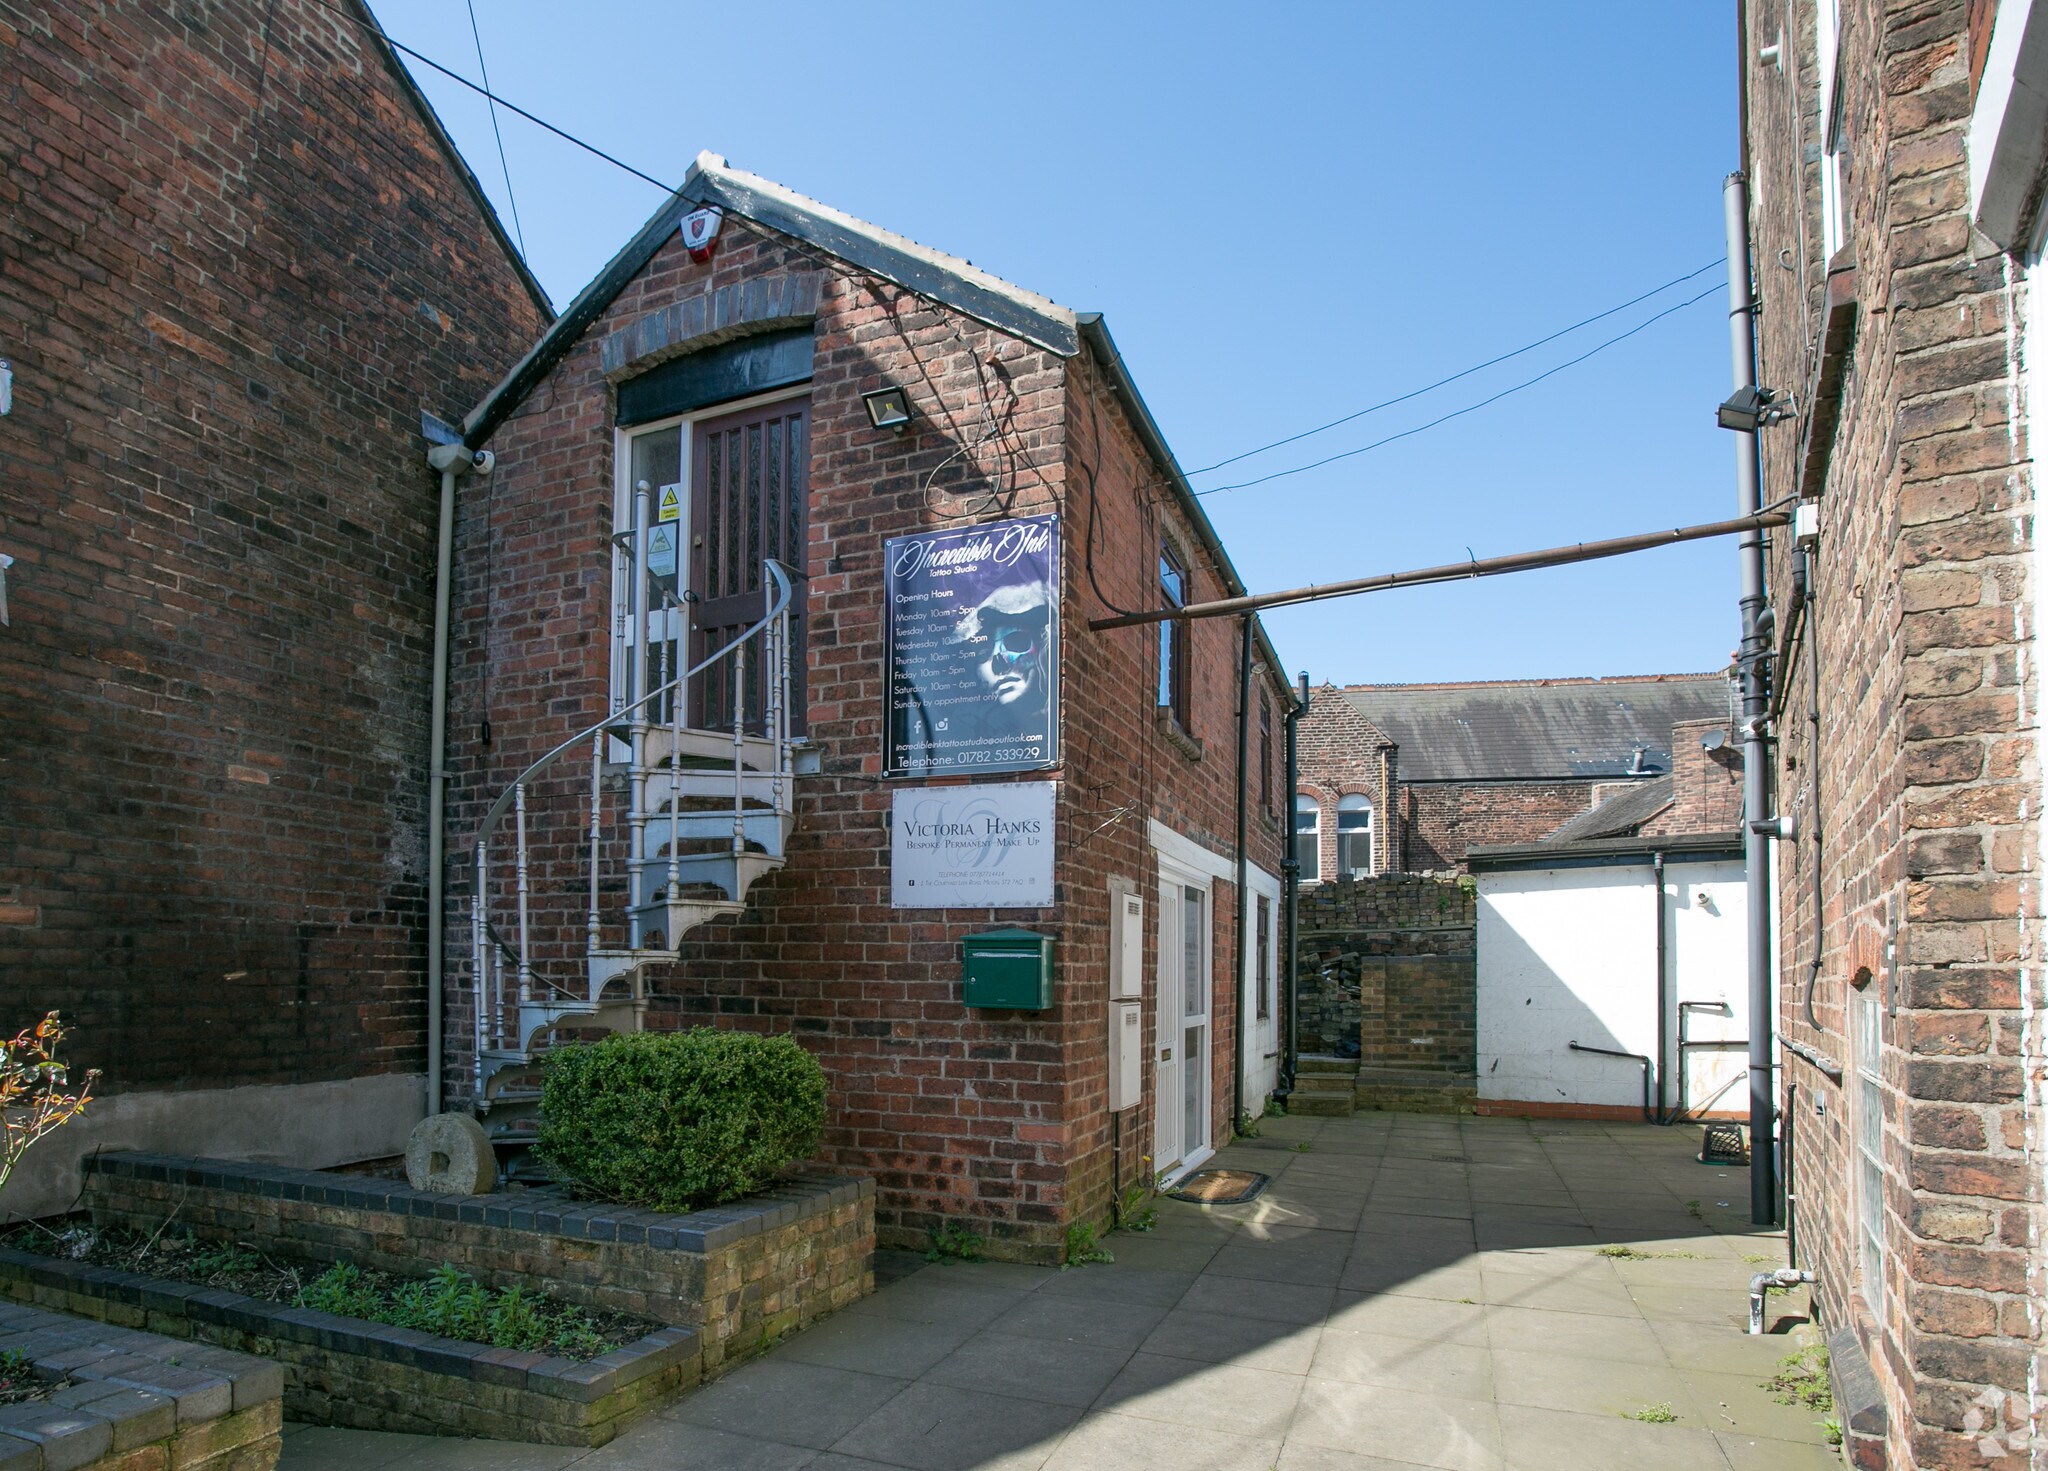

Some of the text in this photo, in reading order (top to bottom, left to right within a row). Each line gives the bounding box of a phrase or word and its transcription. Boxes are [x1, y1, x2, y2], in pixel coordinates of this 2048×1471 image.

[893, 523, 1049, 581] Incredible Ink
[929, 564, 978, 578] Tattoo Studio
[895, 589, 954, 604] Opening Hours
[895, 611, 928, 622] Monday
[930, 608, 951, 618] 10am
[958, 605, 977, 616] 5pm
[895, 626, 925, 637] Tuesday
[927, 623, 948, 633] 10am
[895, 640, 939, 651] Wednesday
[970, 634, 988, 644] 5pm
[895, 654, 927, 666] Thursday
[930, 652, 950, 662] 10am
[958, 650, 976, 661] 5pm
[894, 670, 918, 682] Friday
[920, 667, 940, 677] 10am
[948, 666, 966, 676] 5pm
[894, 684, 927, 696] Saturday
[930, 682, 951, 692] 10am
[958, 680, 977, 691] 6pm
[893, 692, 999, 710] Sunday by appointment only
[898, 746, 1040, 769] Telephone: 01782 533929
